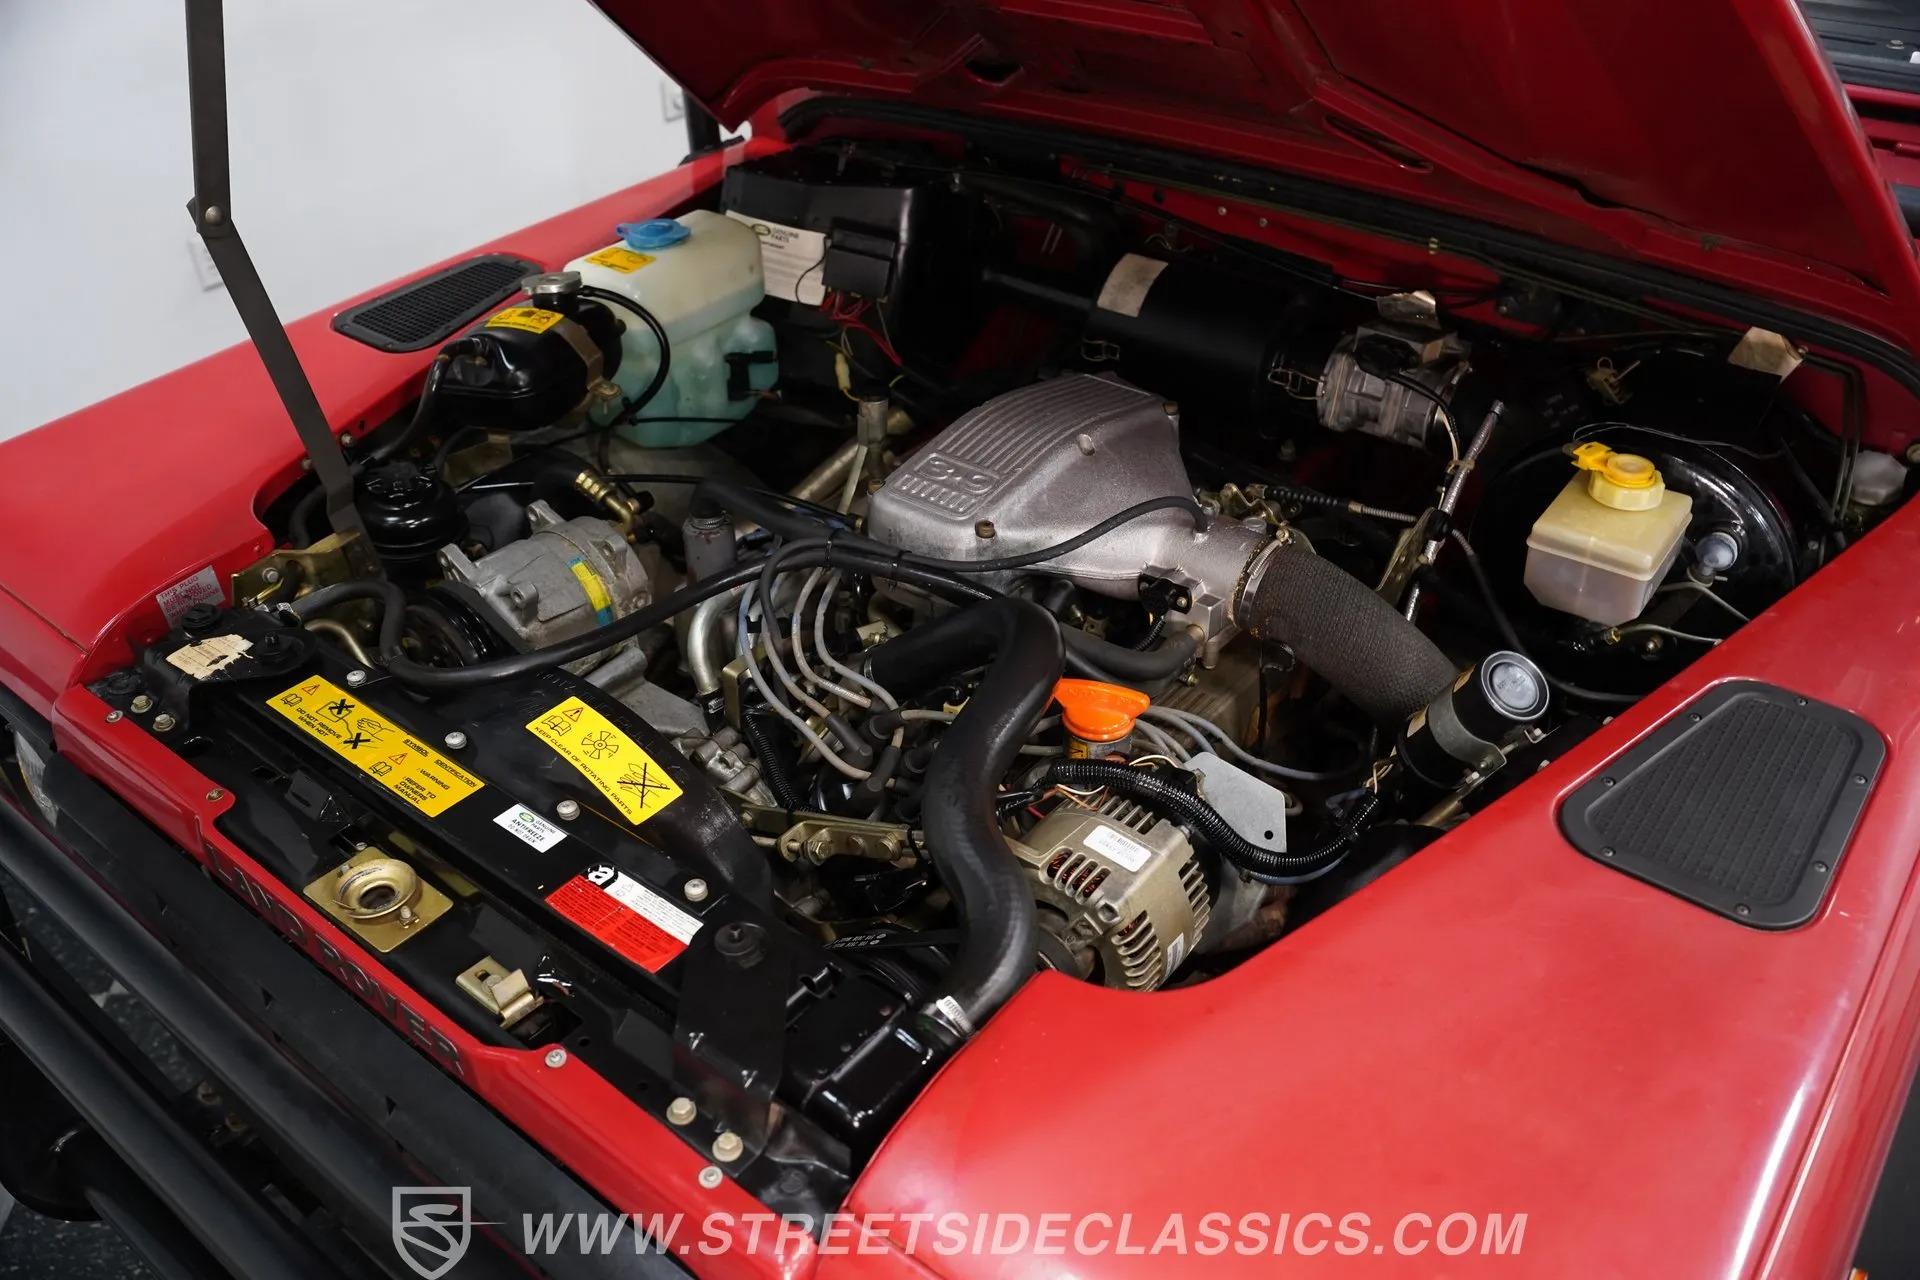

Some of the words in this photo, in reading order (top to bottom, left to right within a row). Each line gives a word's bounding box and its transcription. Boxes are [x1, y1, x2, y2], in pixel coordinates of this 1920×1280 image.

[298, 716, 316, 730] WHEN
[315, 725, 330, 737] HOT
[305, 713, 319, 726] NOT
[318, 721, 343, 740] REMOVE
[402, 738, 430, 757] SYMBOL
[434, 758, 478, 787] IDENTIFICATION
[535, 726, 552, 743] KEEP
[551, 738, 572, 757] CLEAR
[571, 753, 582, 764] OF
[580, 763, 612, 793] ROTATING
[611, 792, 633, 815] PARTS
[394, 784, 421, 805] MANUAL
[399, 781, 428, 801] OWNERS
[425, 788, 437, 799] TO
[512, 819, 545, 841] ANTIFREEZE
[205, 843, 307, 946] LAND
[314, 933, 465, 1078] ROVER
